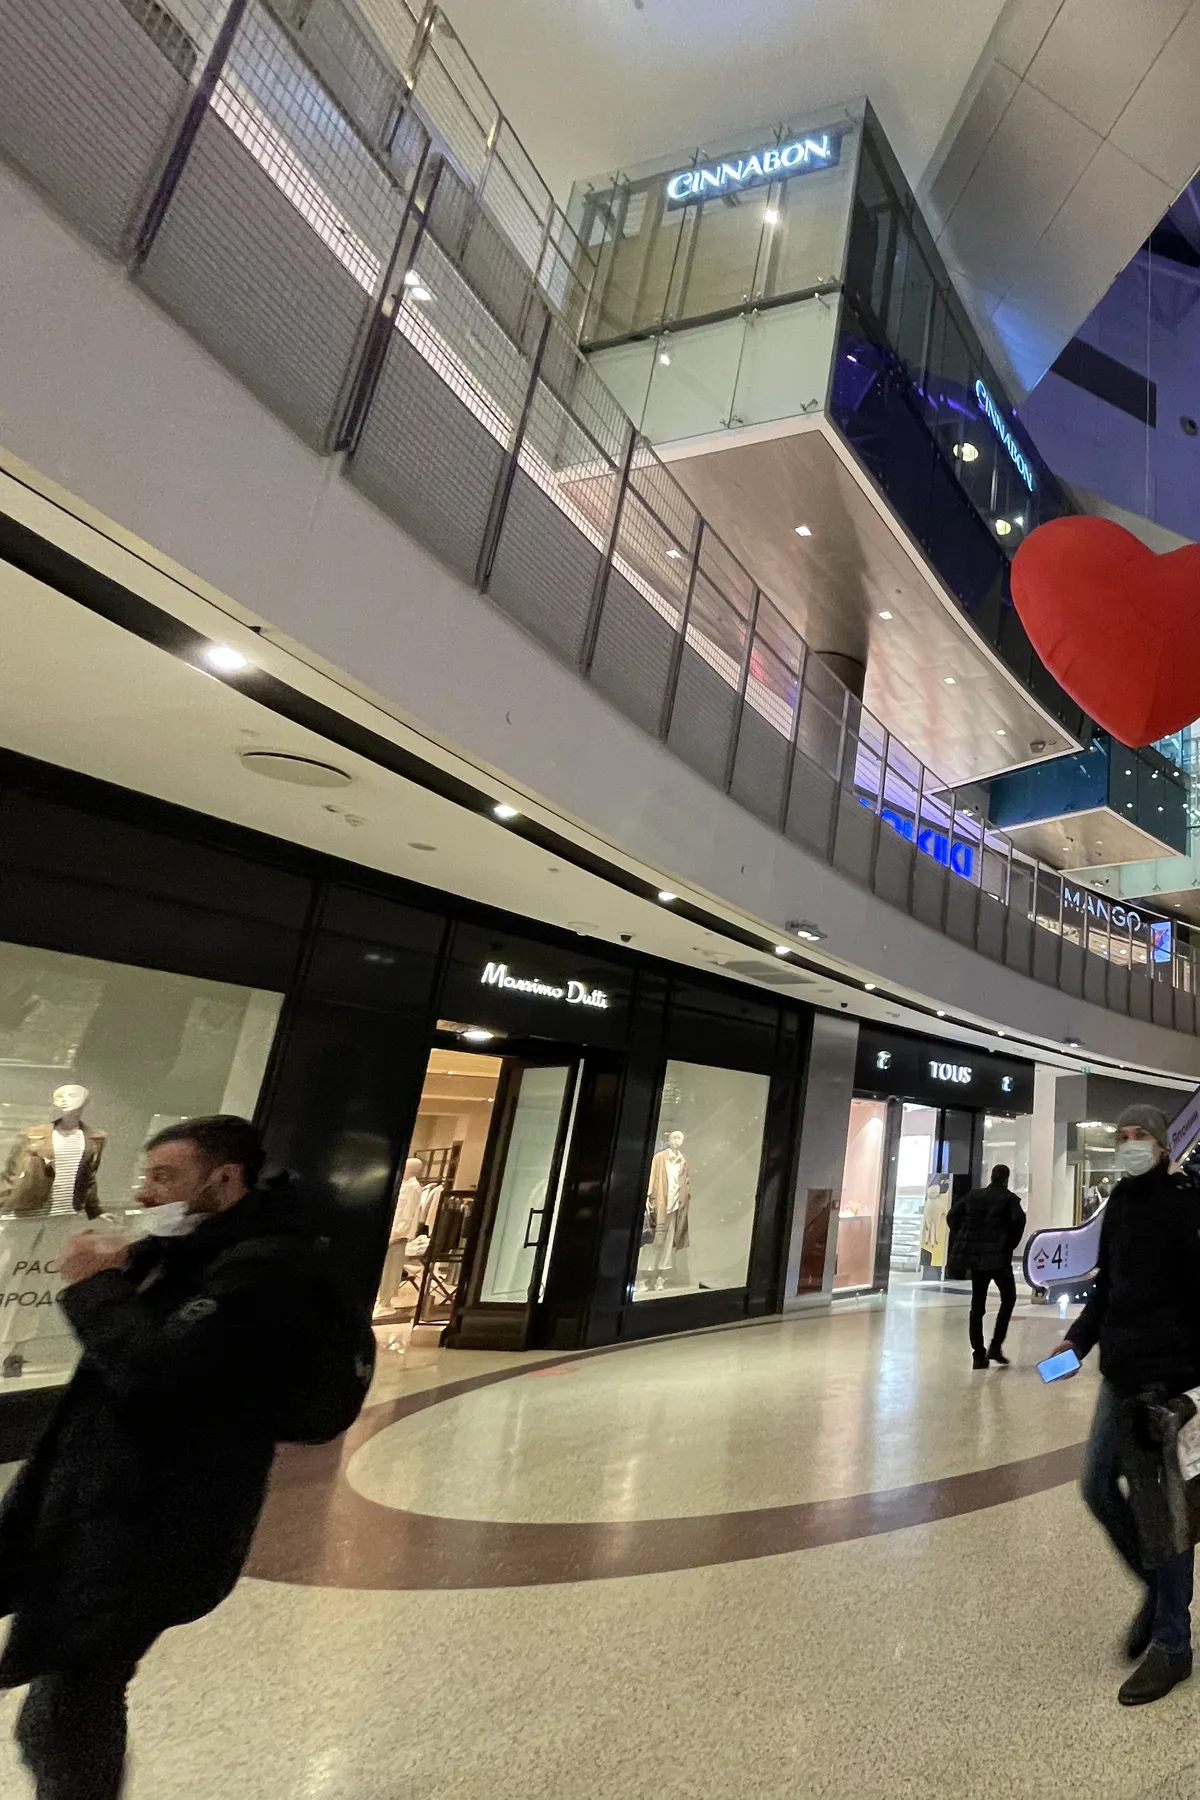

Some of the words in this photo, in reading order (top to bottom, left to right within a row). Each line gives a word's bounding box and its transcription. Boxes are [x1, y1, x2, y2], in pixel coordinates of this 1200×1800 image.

[975, 379, 1034, 492] CINNABON
[1064, 886, 1142, 932] MANGO
[480, 961, 563, 999] Massimo
[564, 980, 609, 1009] Dutti
[928, 1060, 973, 1084] TOUS
[1051, 1243, 1063, 1270] 4
[0, 1290, 60, 1309] РОД
